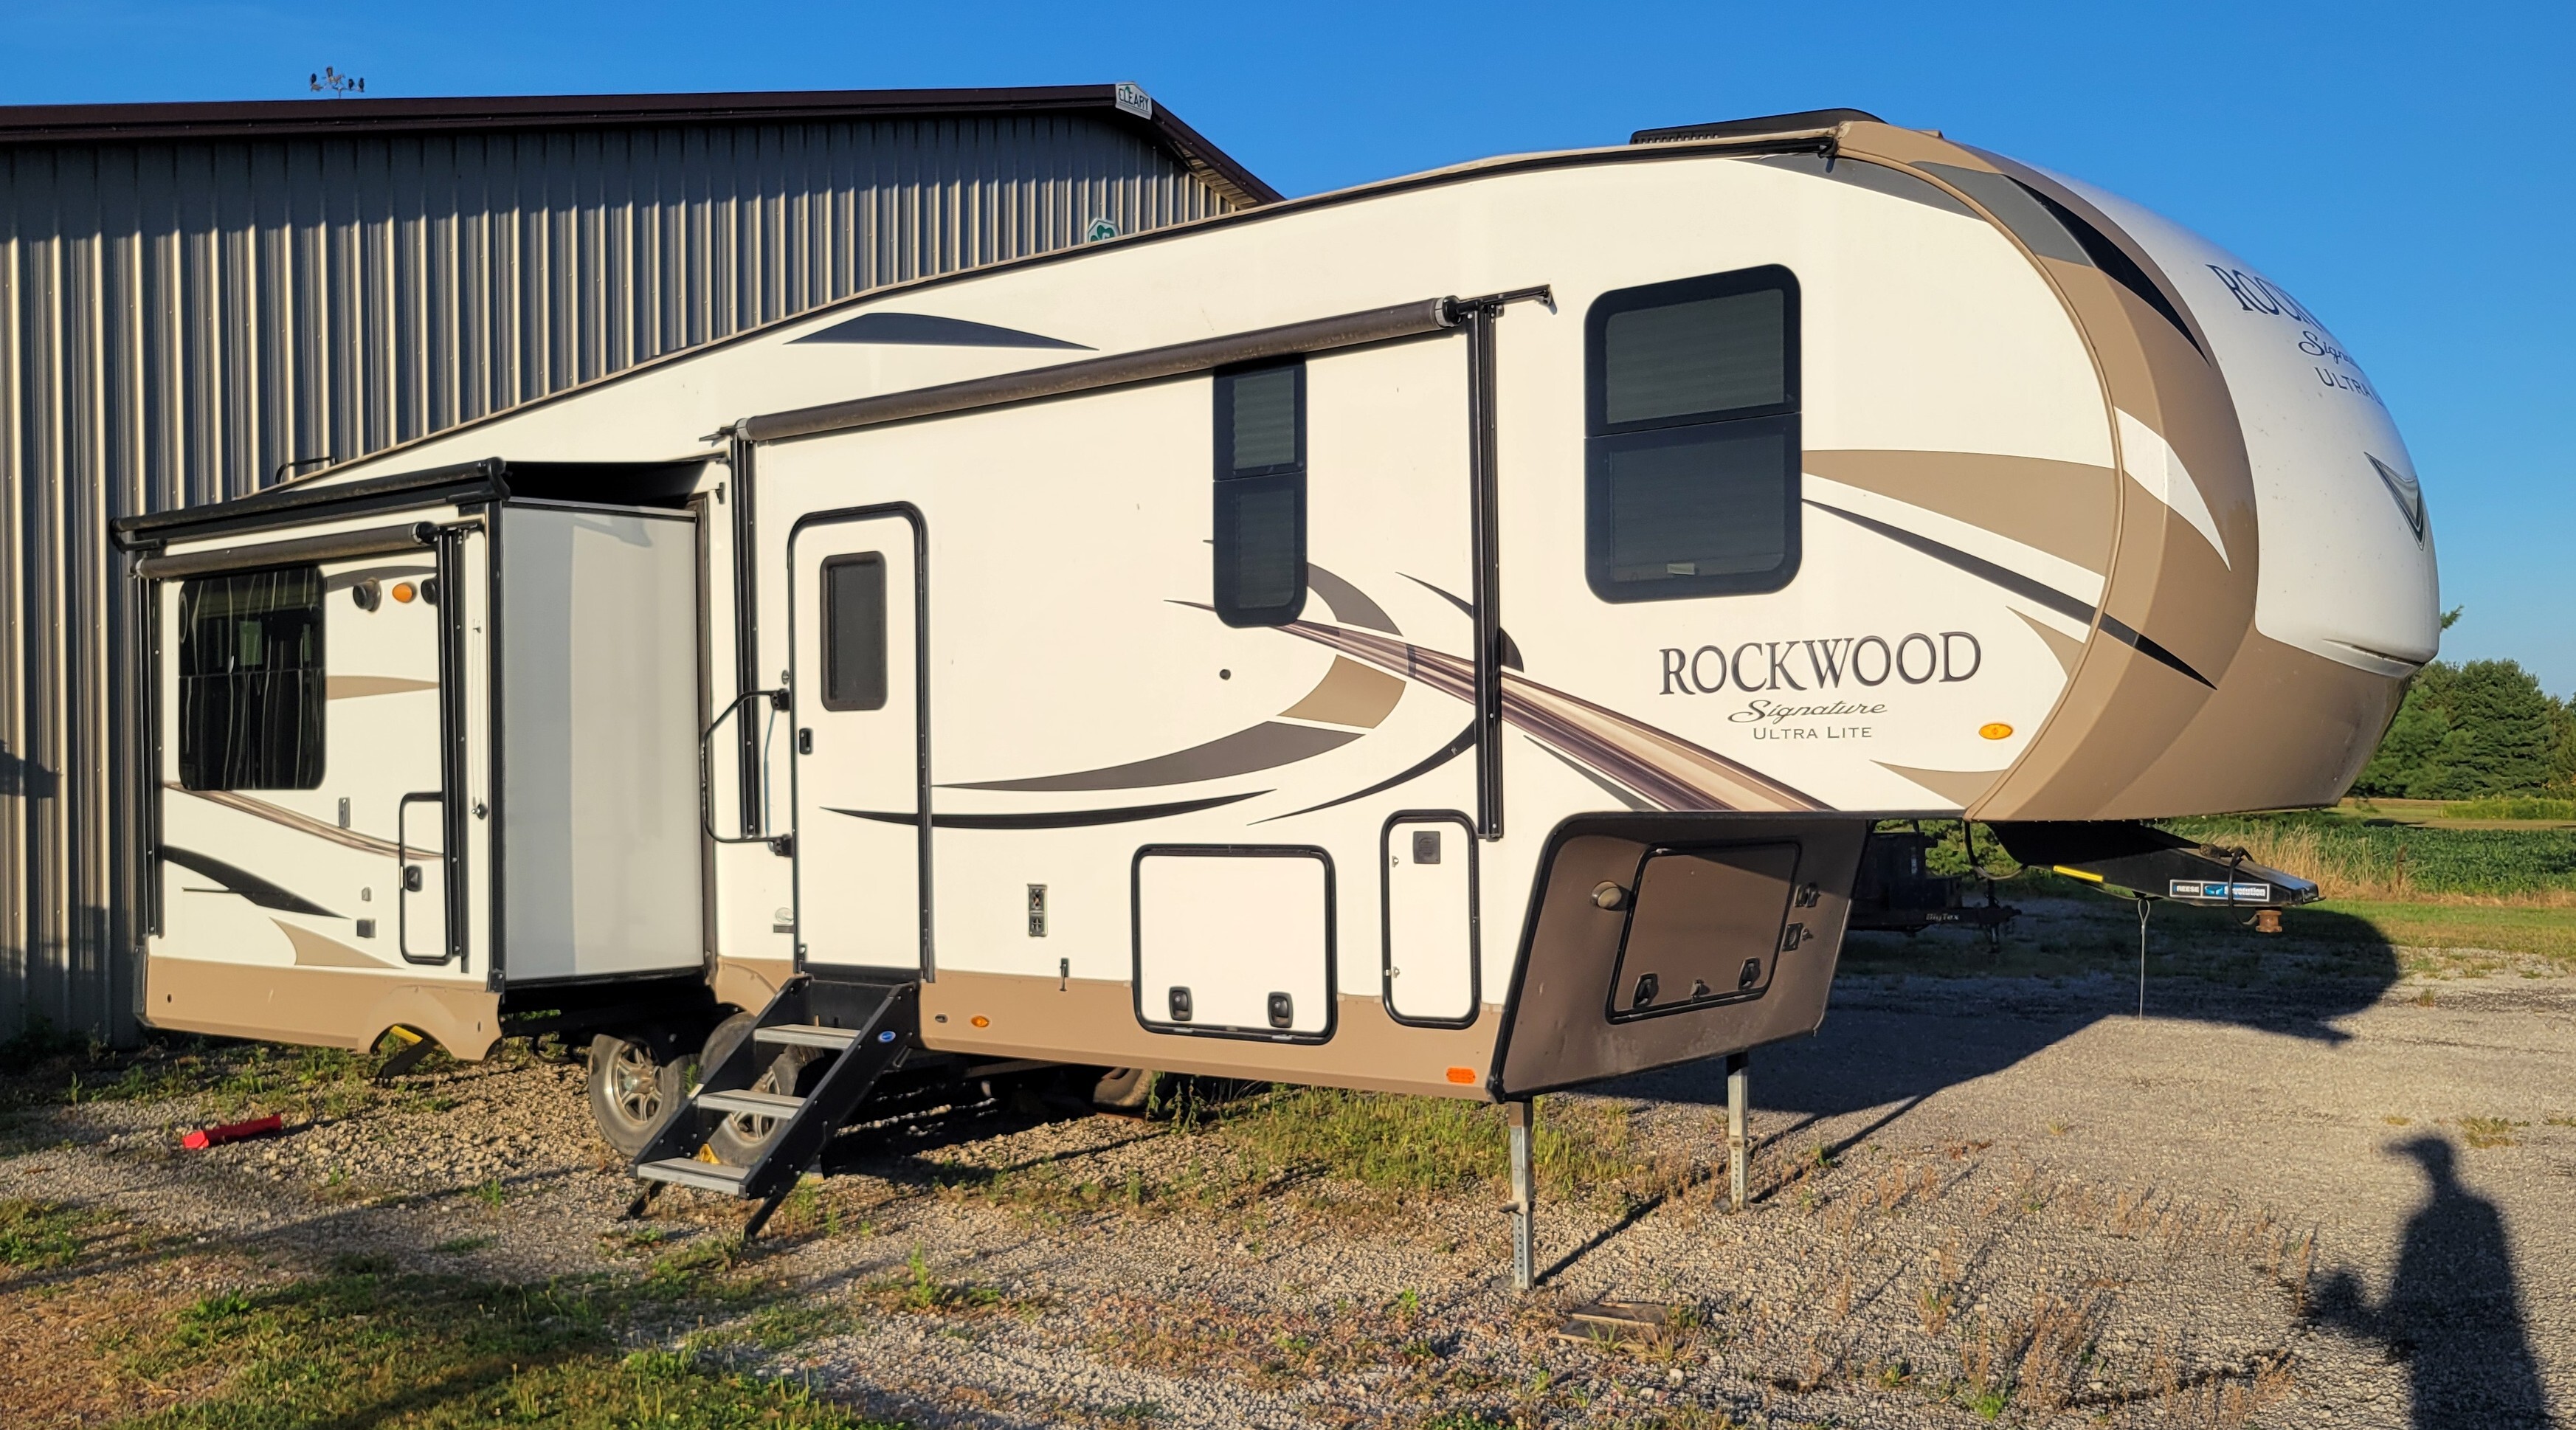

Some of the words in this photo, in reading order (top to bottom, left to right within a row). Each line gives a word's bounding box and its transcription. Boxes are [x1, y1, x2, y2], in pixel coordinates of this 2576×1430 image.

[1119, 88, 1149, 111] CLEARY
[2314, 367, 2375, 401] ULTRA
[1659, 631, 1982, 696] ROCKWOOD
[1727, 700, 1888, 725] Signature
[1753, 727, 1818, 740] ULTRA
[1826, 726, 1873, 739] LITE
[2176, 885, 2200, 894] REESE
